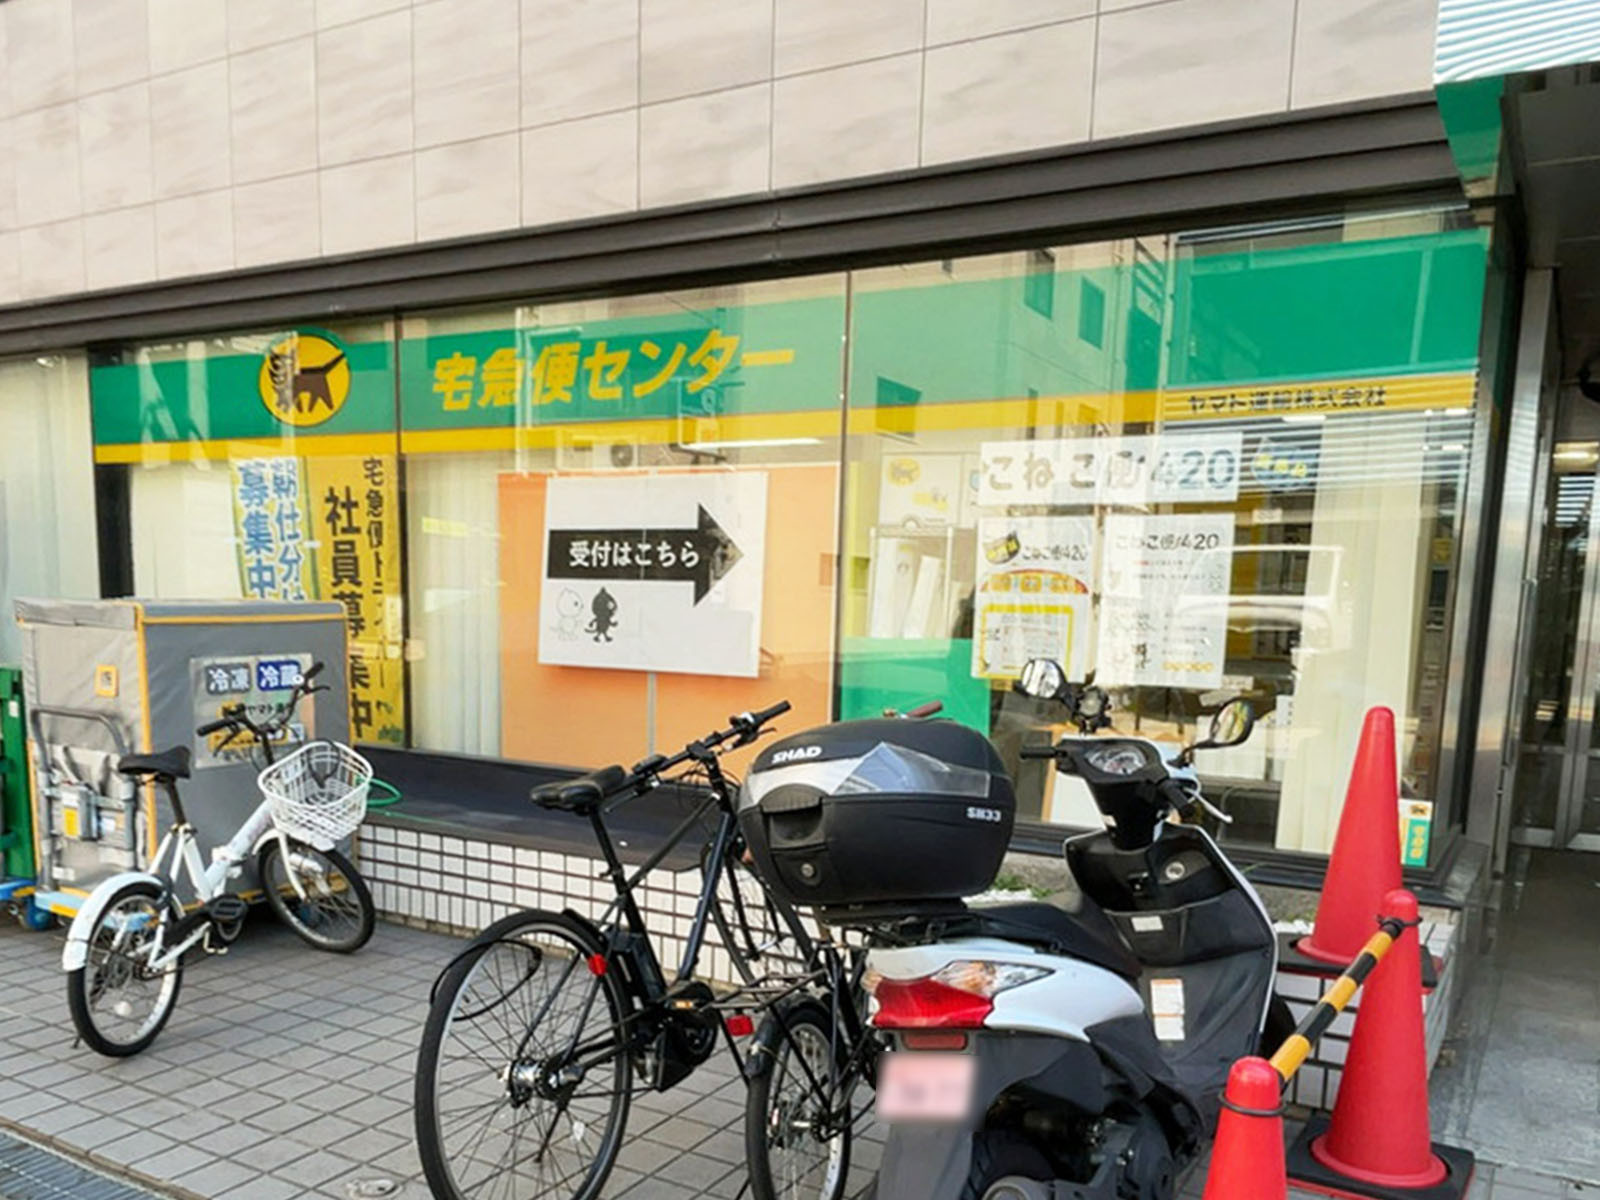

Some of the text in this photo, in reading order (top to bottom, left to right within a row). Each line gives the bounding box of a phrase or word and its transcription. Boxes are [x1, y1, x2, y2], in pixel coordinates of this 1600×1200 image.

[431, 329, 796, 412] 宅急便センター
[1188, 387, 1387, 412] ヤマト運輸株式会社
[239, 462, 275, 599] 募集中
[569, 540, 700, 569] 受付はこちら
[770, 746, 822, 764] SHAD
